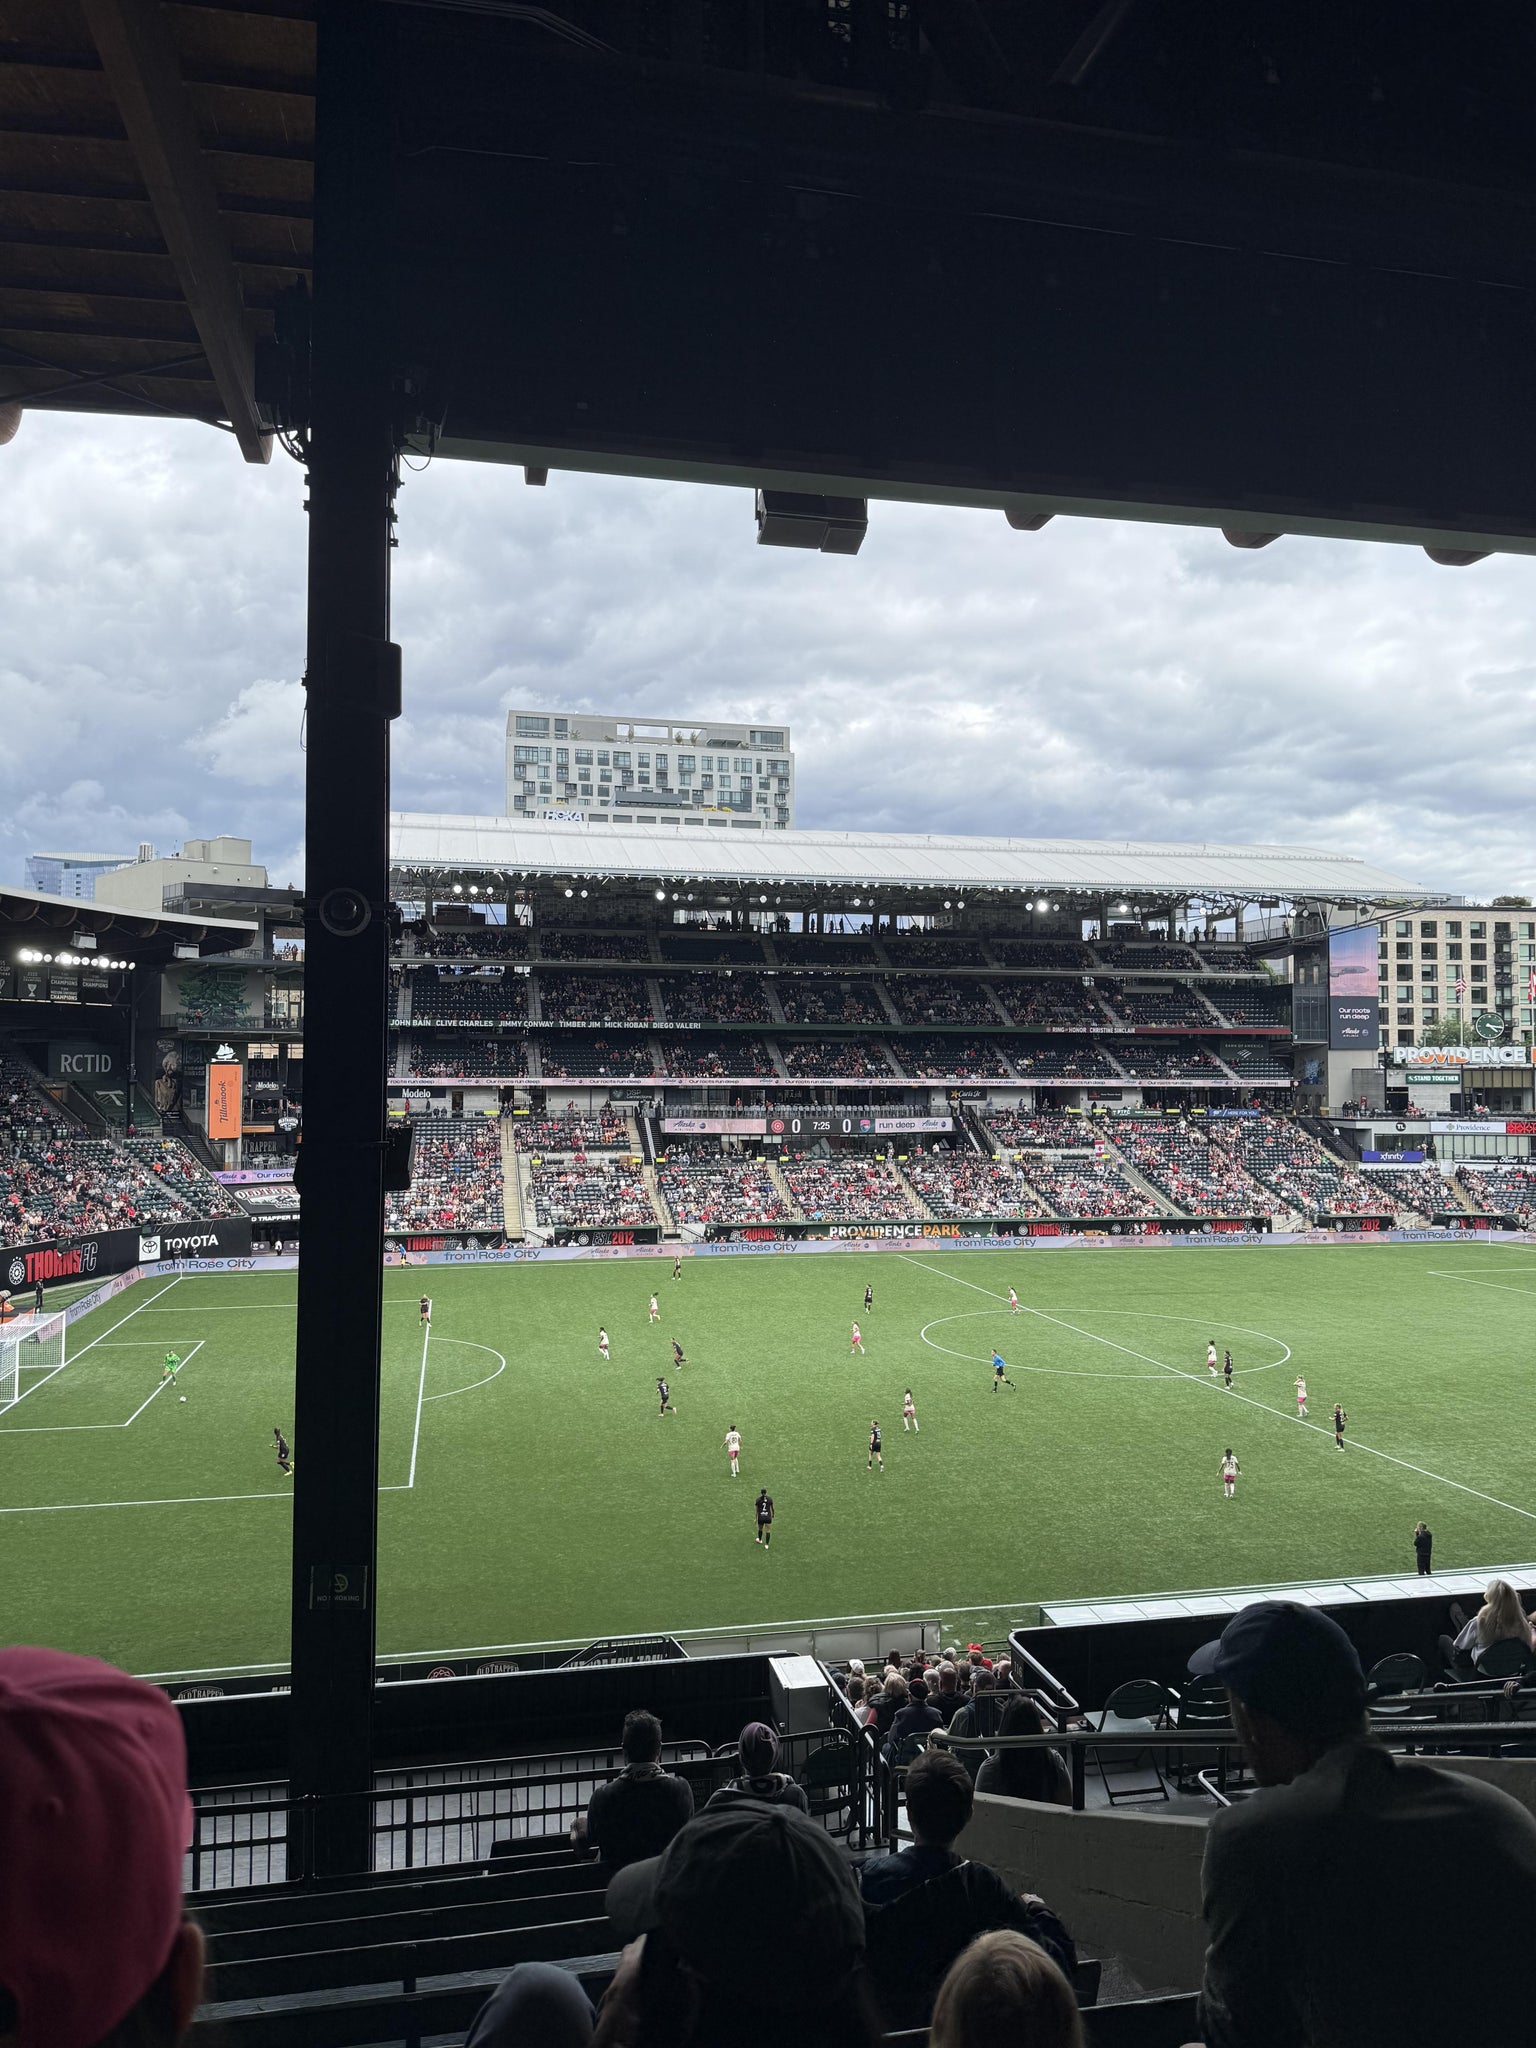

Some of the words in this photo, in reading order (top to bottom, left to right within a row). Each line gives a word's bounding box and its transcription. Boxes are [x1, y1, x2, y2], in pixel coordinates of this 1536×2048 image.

[1393, 1046, 1527, 1064] PROVIDENCE
[60, 1054, 111, 1072] RCTID
[402, 1088, 431, 1098] Modelo
[219, 1080, 228, 1123] Tillamook
[792, 1119, 801, 1133] 0
[813, 1121, 830, 1130] 7:25
[842, 1119, 851, 1133] 0
[896, 1121, 915, 1129] deep
[1456, 1123, 1491, 1131] Providence
[243, 1139, 277, 1153] TRAPPER
[1380, 1152, 1404, 1161] xfinity
[1361, 1219, 1380, 1231] 2012
[612, 1231, 635, 1246] 2012
[1185, 1235, 1210, 1243] from
[1213, 1235, 1238, 1243] Rose
[1241, 1234, 1263, 1244] City
[1403, 1231, 1426, 1240] from
[1428, 1231, 1451, 1239] Rose
[1454, 1231, 1474, 1240] City
[165, 1235, 218, 1250] TOYOTA
[711, 1242, 738, 1253] from
[741, 1242, 771, 1252] Rose
[773, 1241, 798, 1252] City
[954, 1238, 980, 1247] from
[983, 1238, 1010, 1247] Rose
[1013, 1238, 1036, 1248] City
[444, 1251, 476, 1261] from
[479, 1251, 511, 1260] Rose
[513, 1249, 540, 1260] City
[25, 1248, 80, 1283] THORNS
[79, 1241, 98, 1273] FC
[157, 1261, 185, 1272] from
[188, 1259, 224, 1269] Rose
[227, 1258, 256, 1270] City
